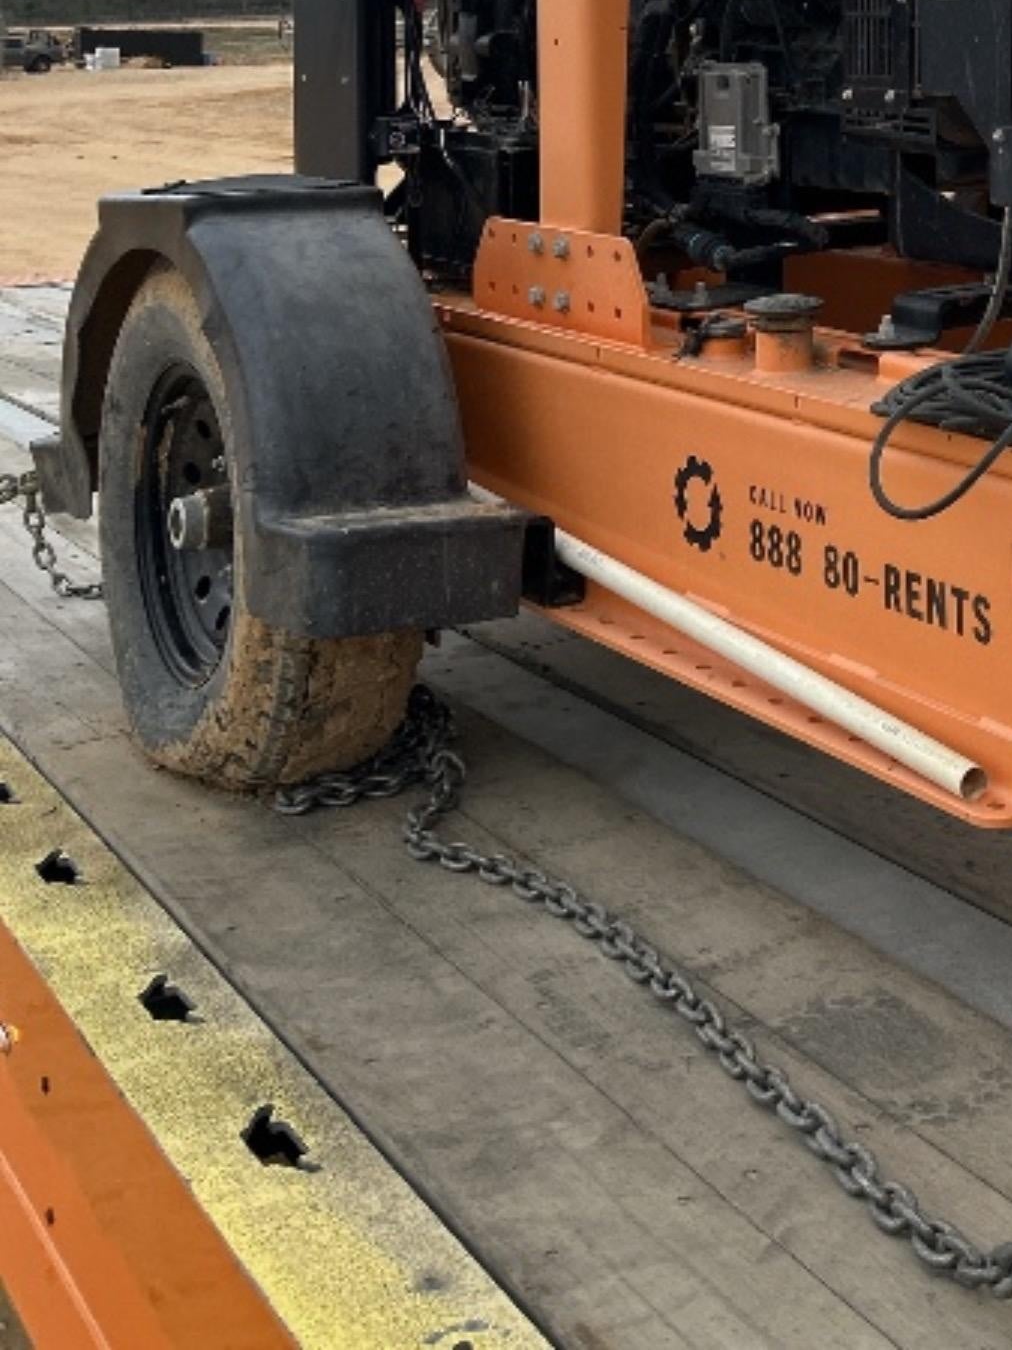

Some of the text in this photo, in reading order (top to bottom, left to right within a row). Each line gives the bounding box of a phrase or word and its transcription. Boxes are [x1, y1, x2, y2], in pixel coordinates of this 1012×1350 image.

[749, 485, 827, 526] CALL NOW
[750, 518, 993, 646] 888 80-RENTS
